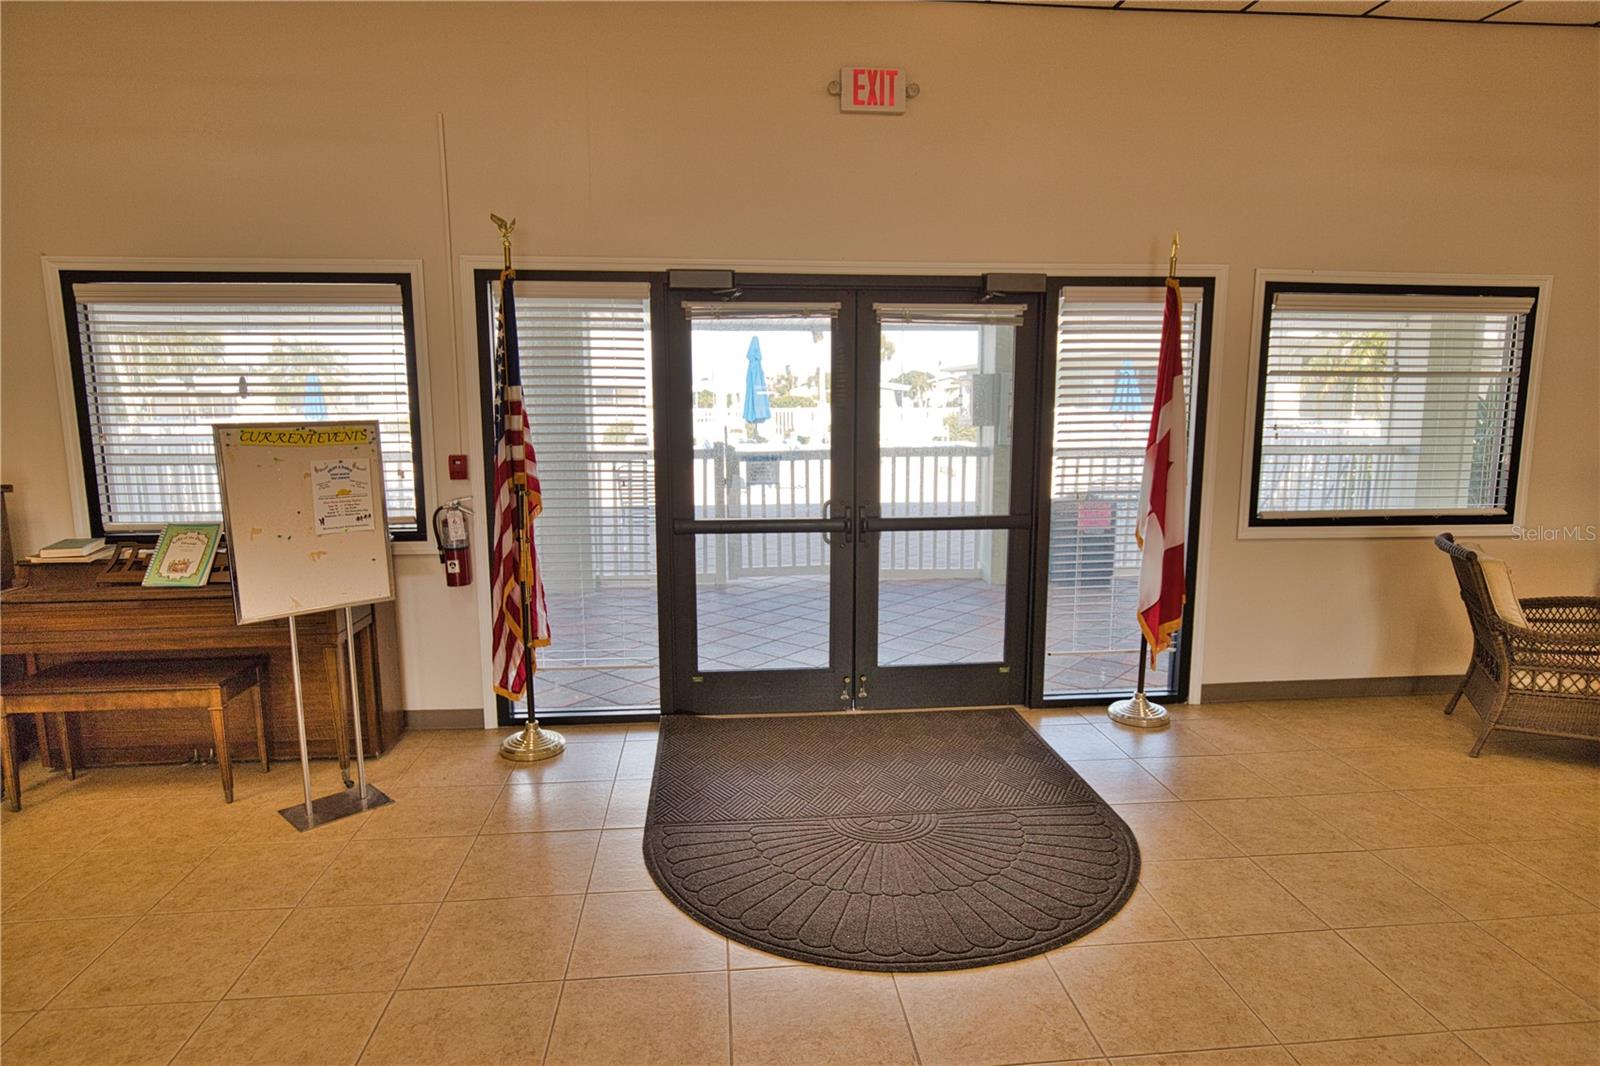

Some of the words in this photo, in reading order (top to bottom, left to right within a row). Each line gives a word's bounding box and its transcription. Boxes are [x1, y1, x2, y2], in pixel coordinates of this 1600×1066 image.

[853, 69, 899, 106] EXIT
[239, 431, 314, 444] CURRENT
[317, 430, 367, 443] EVENTS
